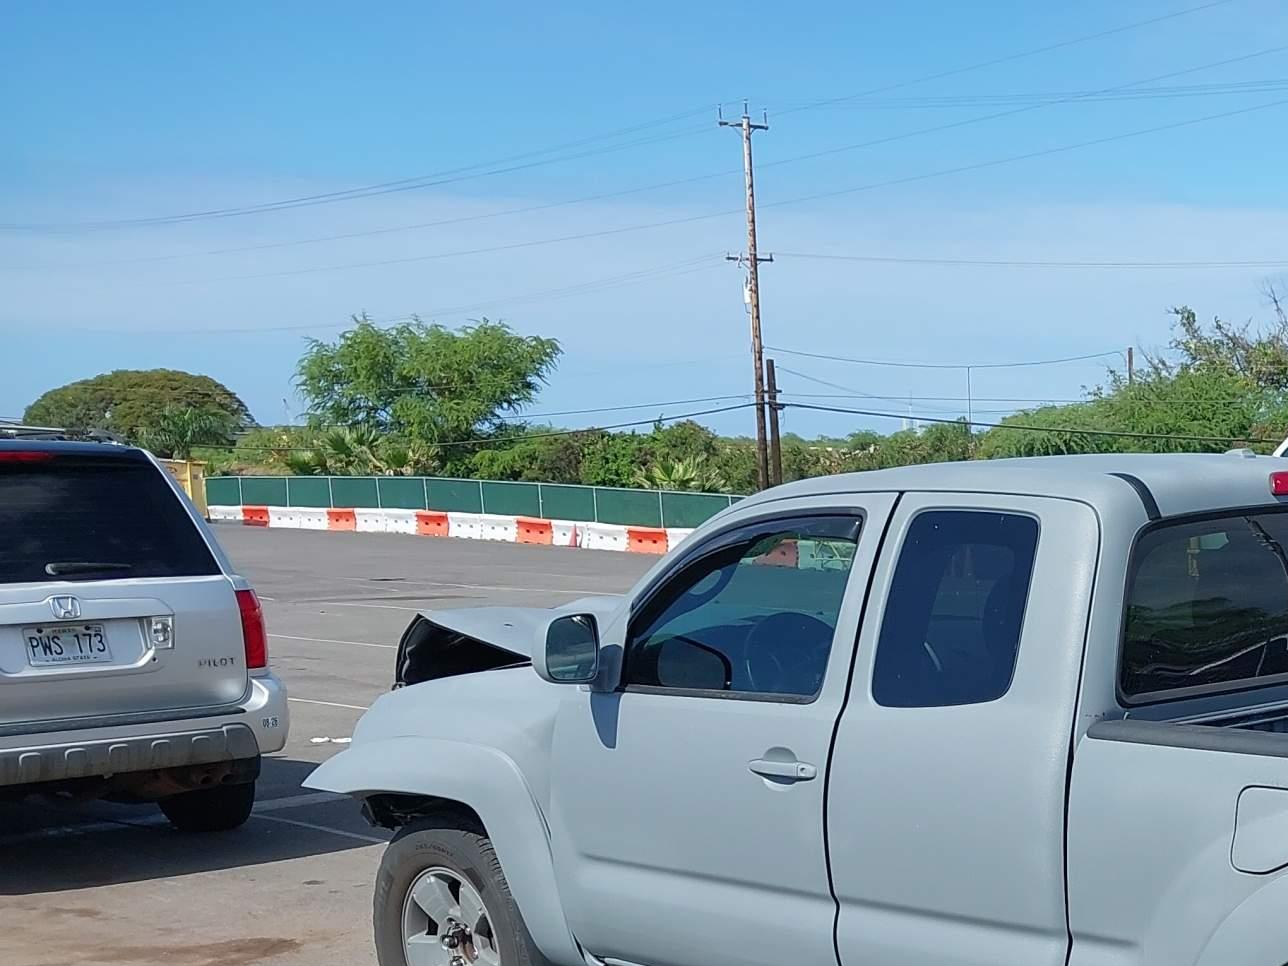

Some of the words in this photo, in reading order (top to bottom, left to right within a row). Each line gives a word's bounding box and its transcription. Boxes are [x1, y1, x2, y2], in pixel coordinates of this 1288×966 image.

[28, 635, 64, 657] PWS
[73, 633, 106, 654] 173
[198, 657, 235, 668] PILOT
